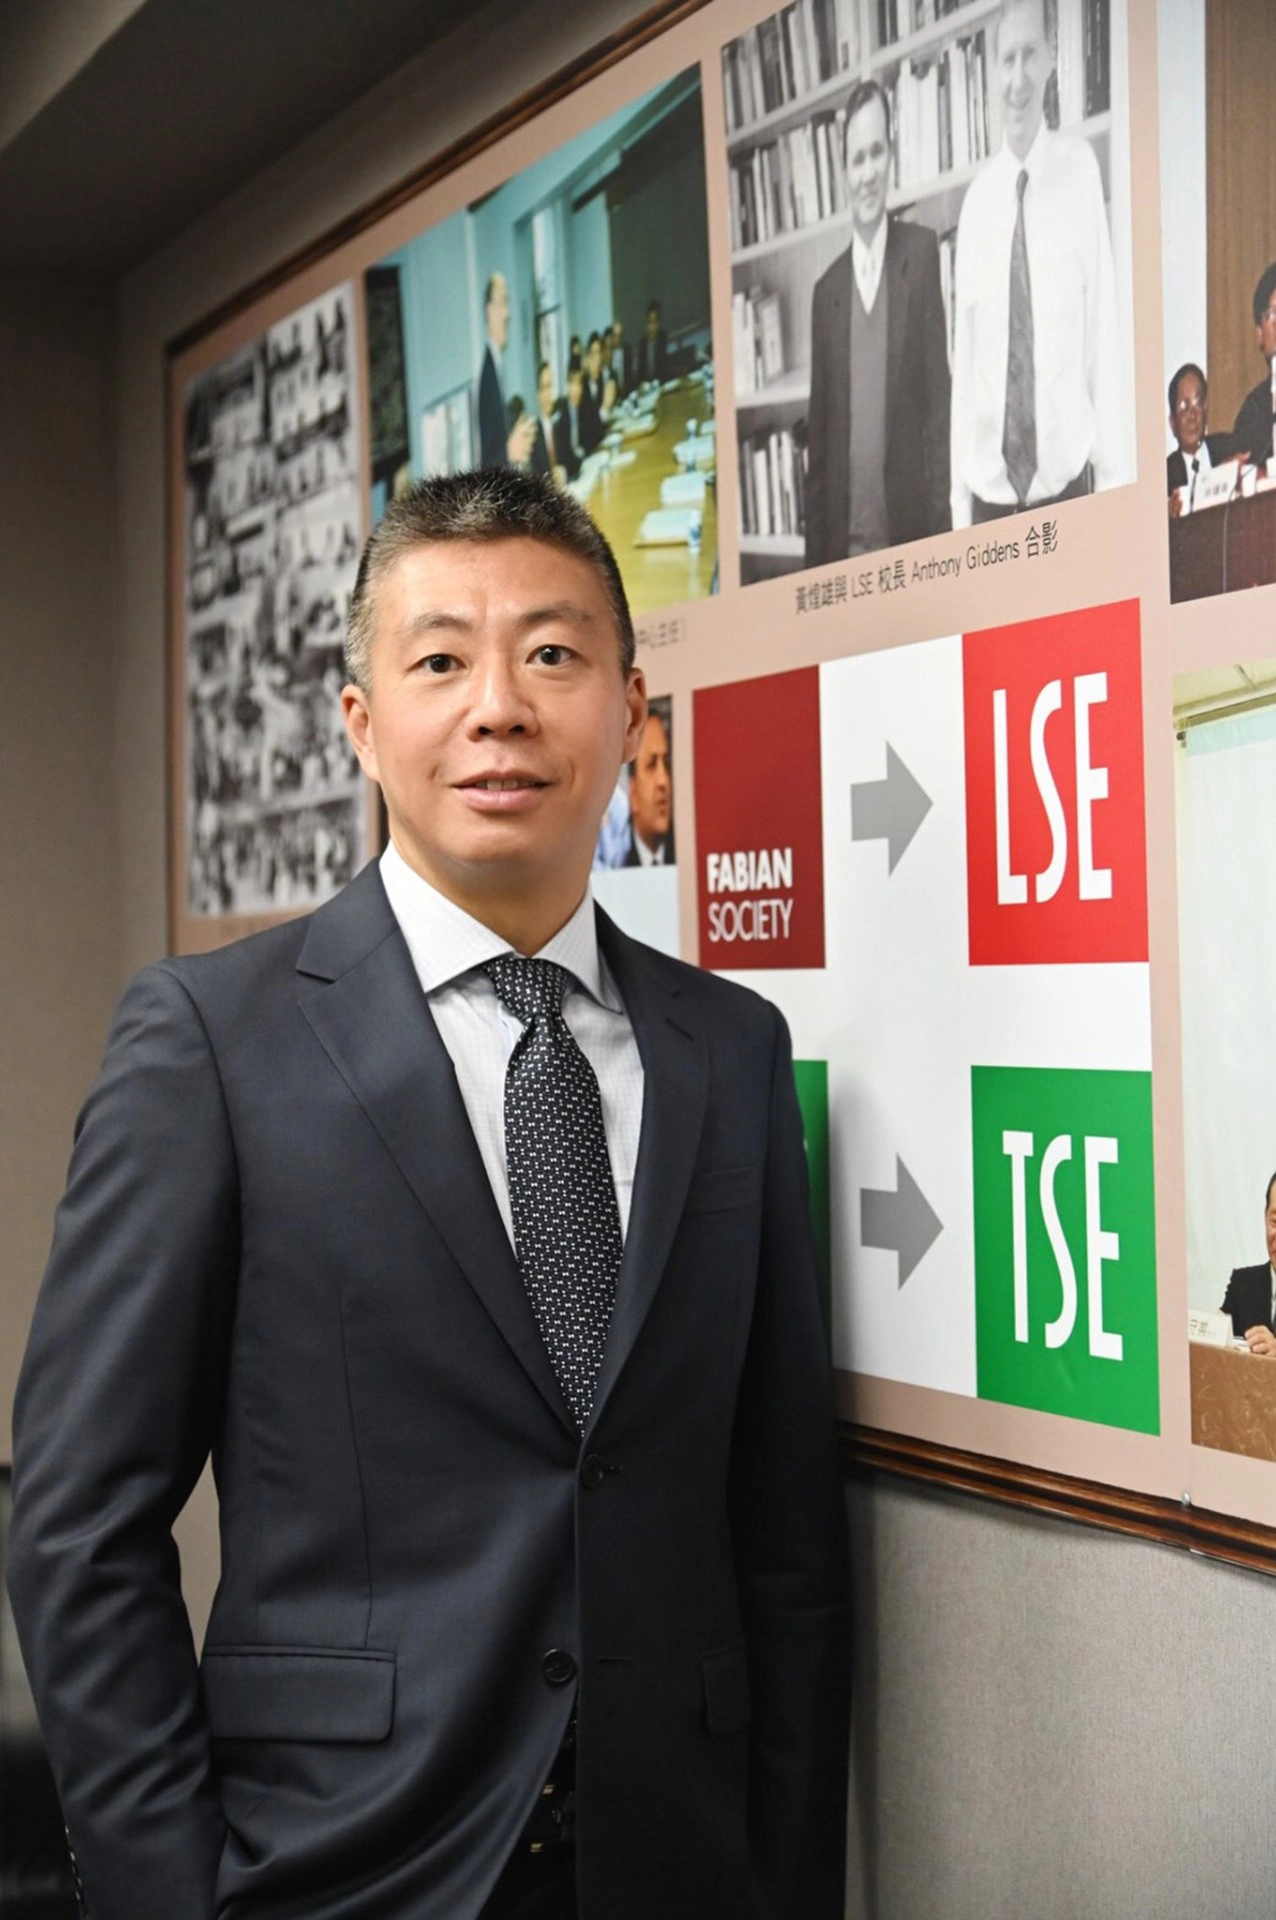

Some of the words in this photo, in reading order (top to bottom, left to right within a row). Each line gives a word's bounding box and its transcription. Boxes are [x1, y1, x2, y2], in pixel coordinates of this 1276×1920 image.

[852, 571, 873, 598] LSE
[878, 560, 906, 593] 校長
[911, 556, 962, 583] Anthony
[966, 540, 1020, 570] Giddens
[1025, 520, 1058, 559] 合影
[993, 671, 1113, 905] LSE
[706, 847, 793, 893] FABIAN
[708, 898, 794, 942] SOCIETY
[1002, 1130, 1123, 1361] TSE
